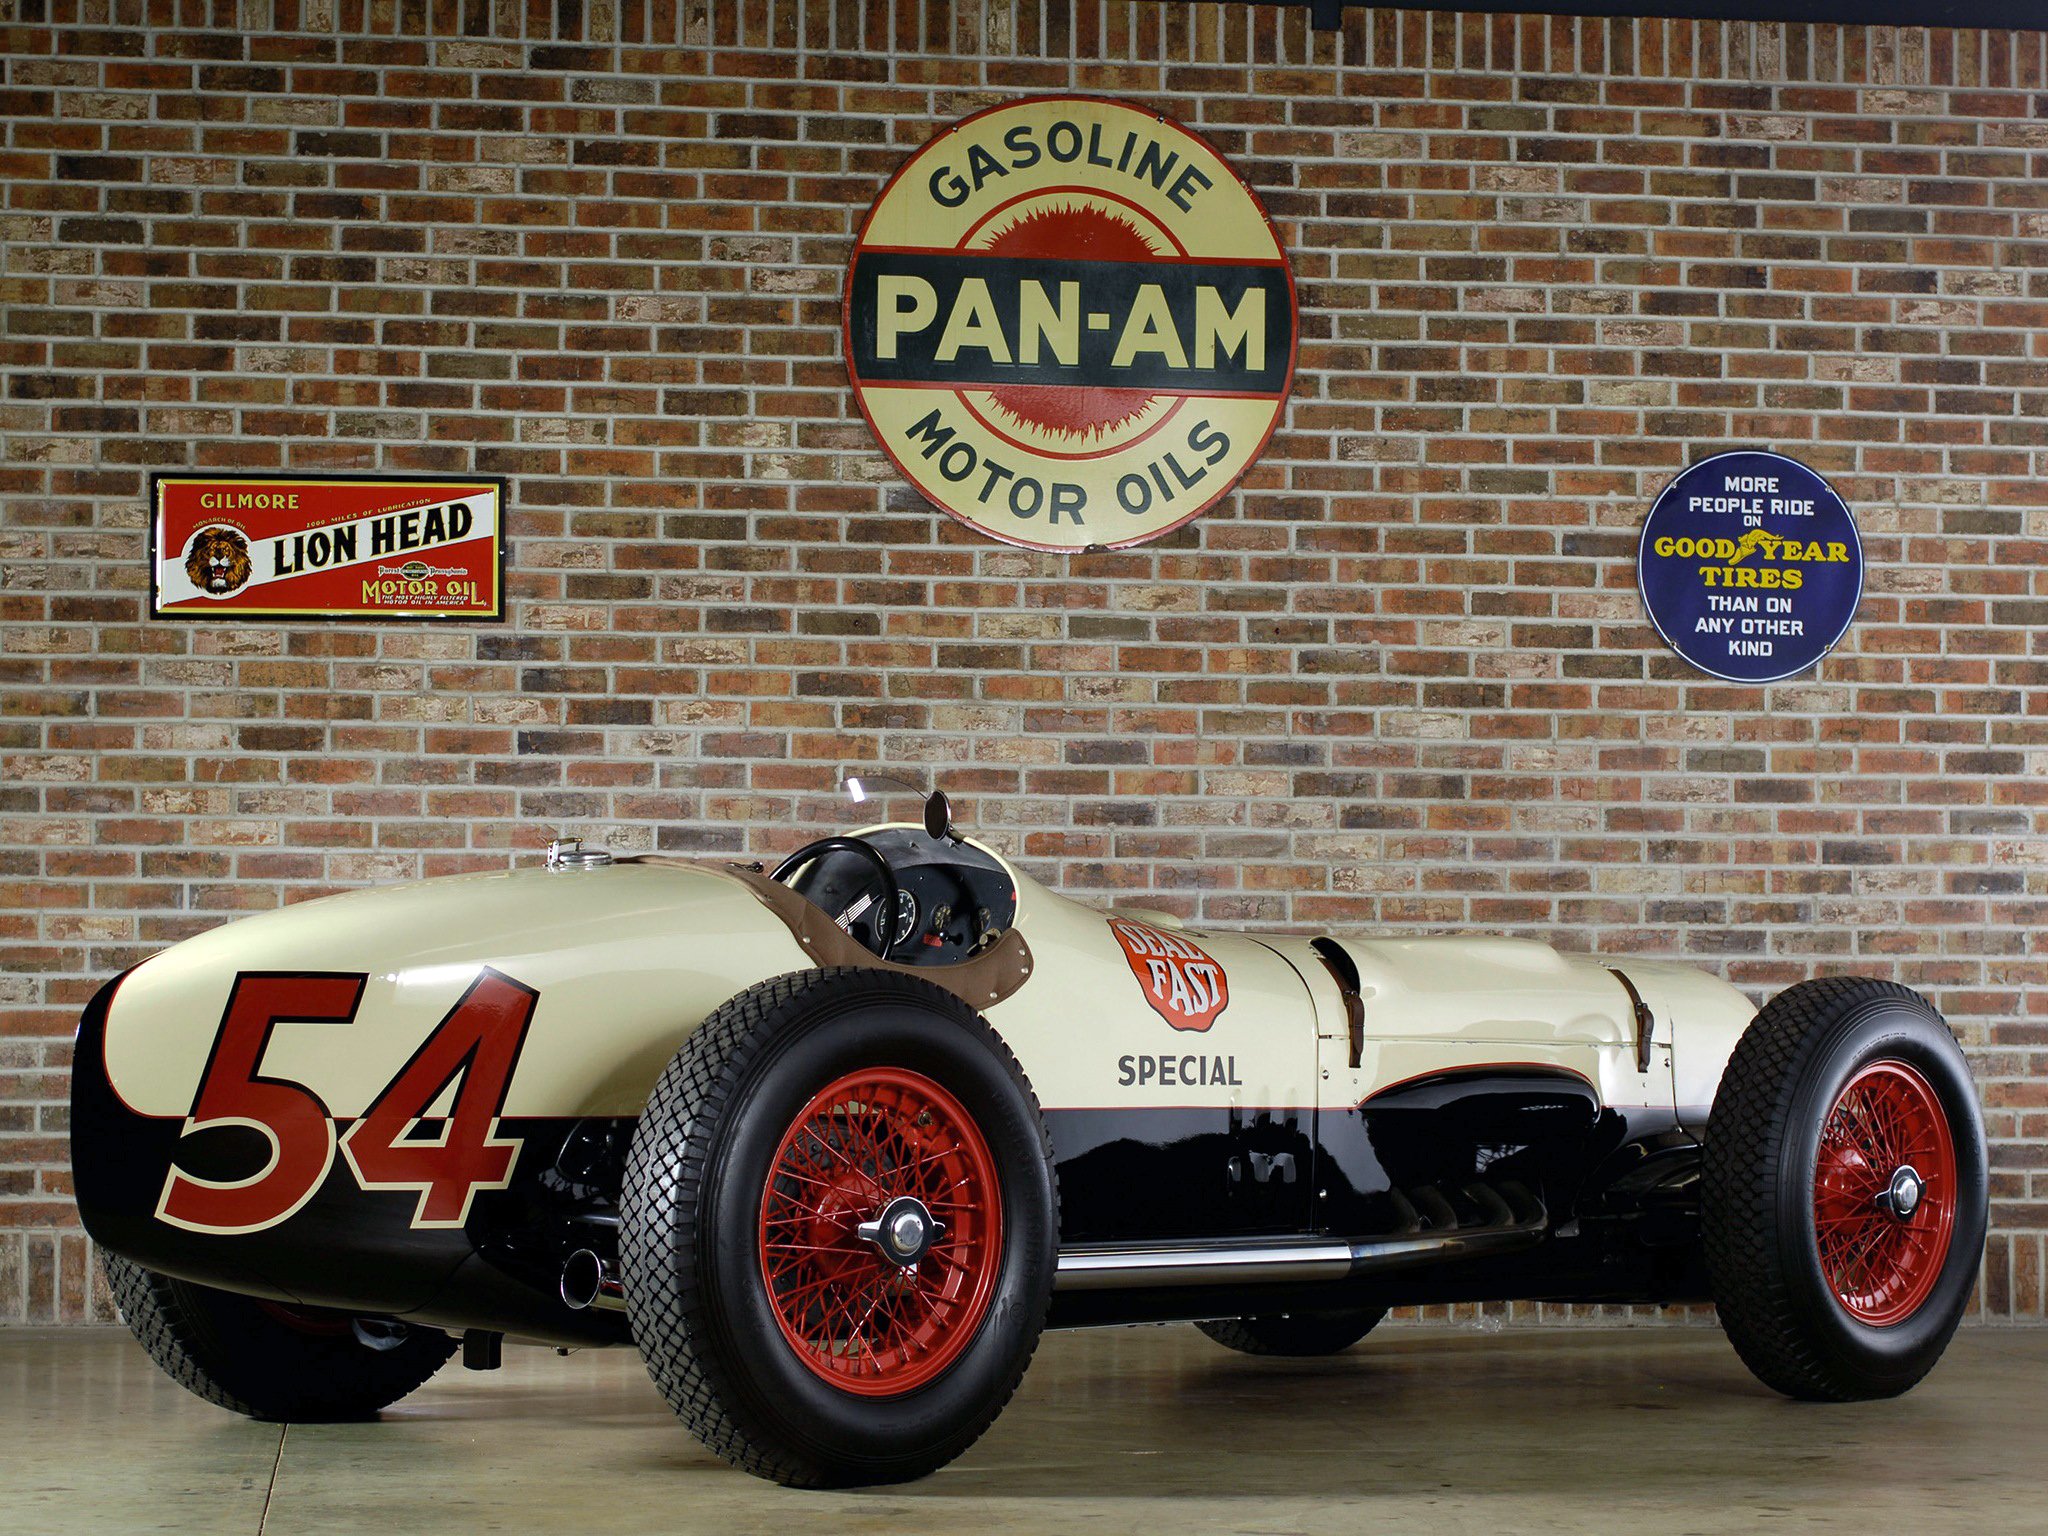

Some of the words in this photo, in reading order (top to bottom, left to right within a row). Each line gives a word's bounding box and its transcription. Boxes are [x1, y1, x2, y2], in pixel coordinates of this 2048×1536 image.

[929, 121, 1213, 213] GASOLINE
[876, 275, 1266, 372] PAN-AM
[905, 408, 1087, 525] MOTOR
[1116, 419, 1230, 514] OILS
[1724, 476, 1779, 493] MORE
[200, 493, 299, 509] GILMORE
[331, 512, 357, 522] MILES
[362, 509, 373, 517] OF
[377, 498, 431, 514] LUBRICATION
[1689, 497, 1764, 514] PEOPLE
[1771, 499, 1815, 516] RIDE
[193, 516, 226, 529] MONARCH
[1743, 515, 1761, 527] ON
[273, 523, 359, 577] LION
[370, 502, 474, 557] HEAD
[1654, 535, 1850, 563] GOODYEAR
[1698, 566, 1804, 590] TIRES
[362, 580, 438, 604] MOTOR
[446, 580, 486, 606] OIL
[1707, 595, 1758, 613] THAN
[1766, 597, 1792, 613] ON
[1695, 617, 1734, 633] ANY
[1741, 619, 1804, 636] OTHER
[1728, 640, 1773, 657] KIND
[1116, 923, 1205, 961] SEAL
[1146, 957, 1221, 1017] FAST
[1117, 1055, 1243, 1087] SPECIAL
[154, 965, 541, 1235] 54
